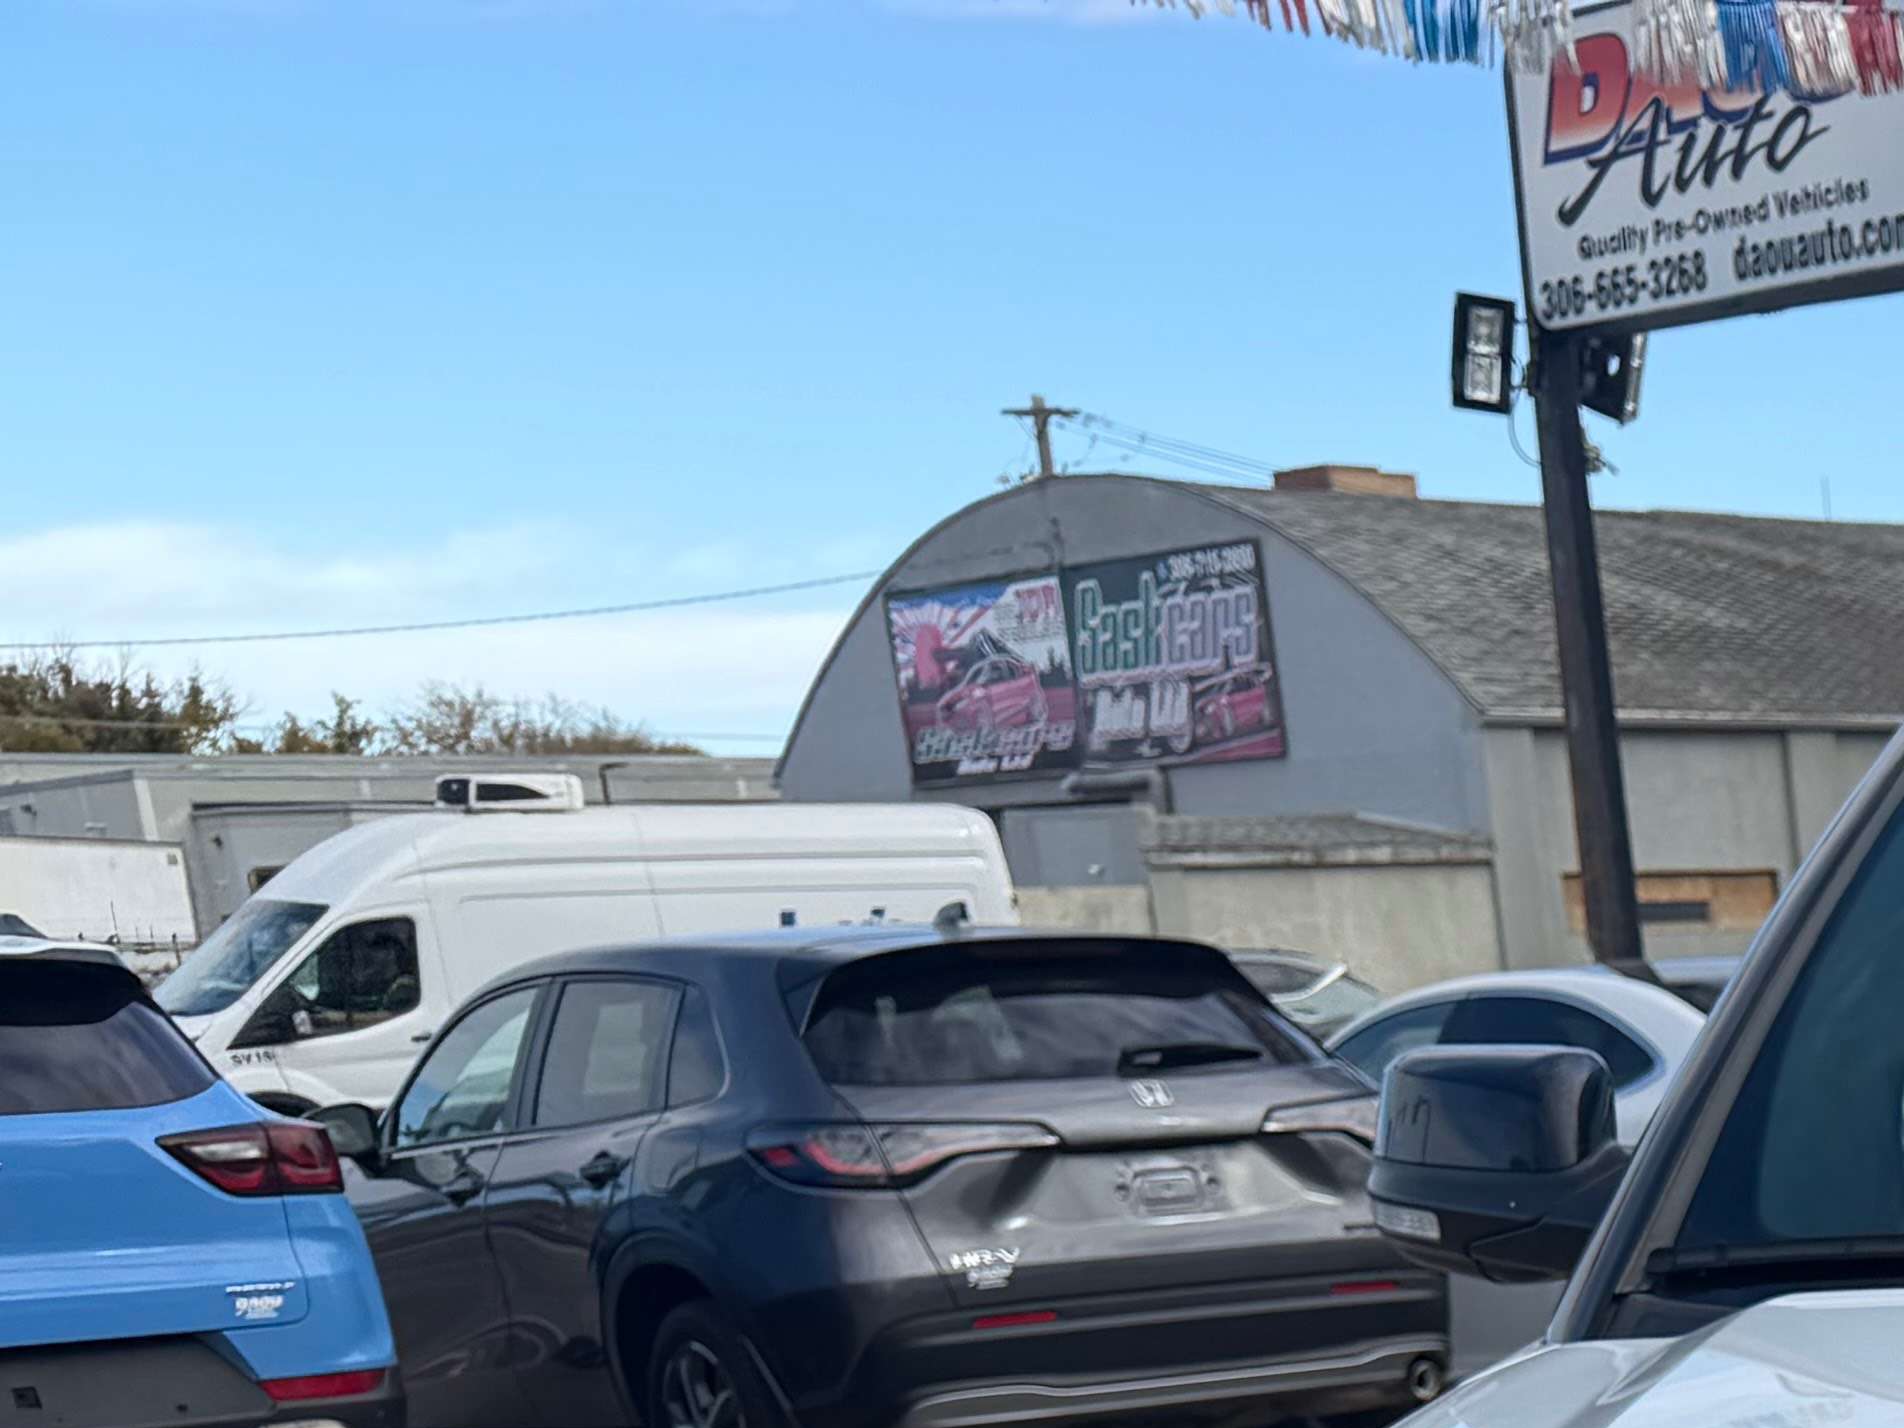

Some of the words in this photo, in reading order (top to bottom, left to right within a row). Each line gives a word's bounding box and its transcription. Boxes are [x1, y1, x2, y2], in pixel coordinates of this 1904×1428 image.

[1557, 94, 1831, 227] Auto
[1577, 225, 1649, 261] Quality
[1653, 193, 1771, 247] Pre-Owned
[1772, 176, 1870, 219] Vehicles
[1540, 248, 1708, 321] 306-665-3268
